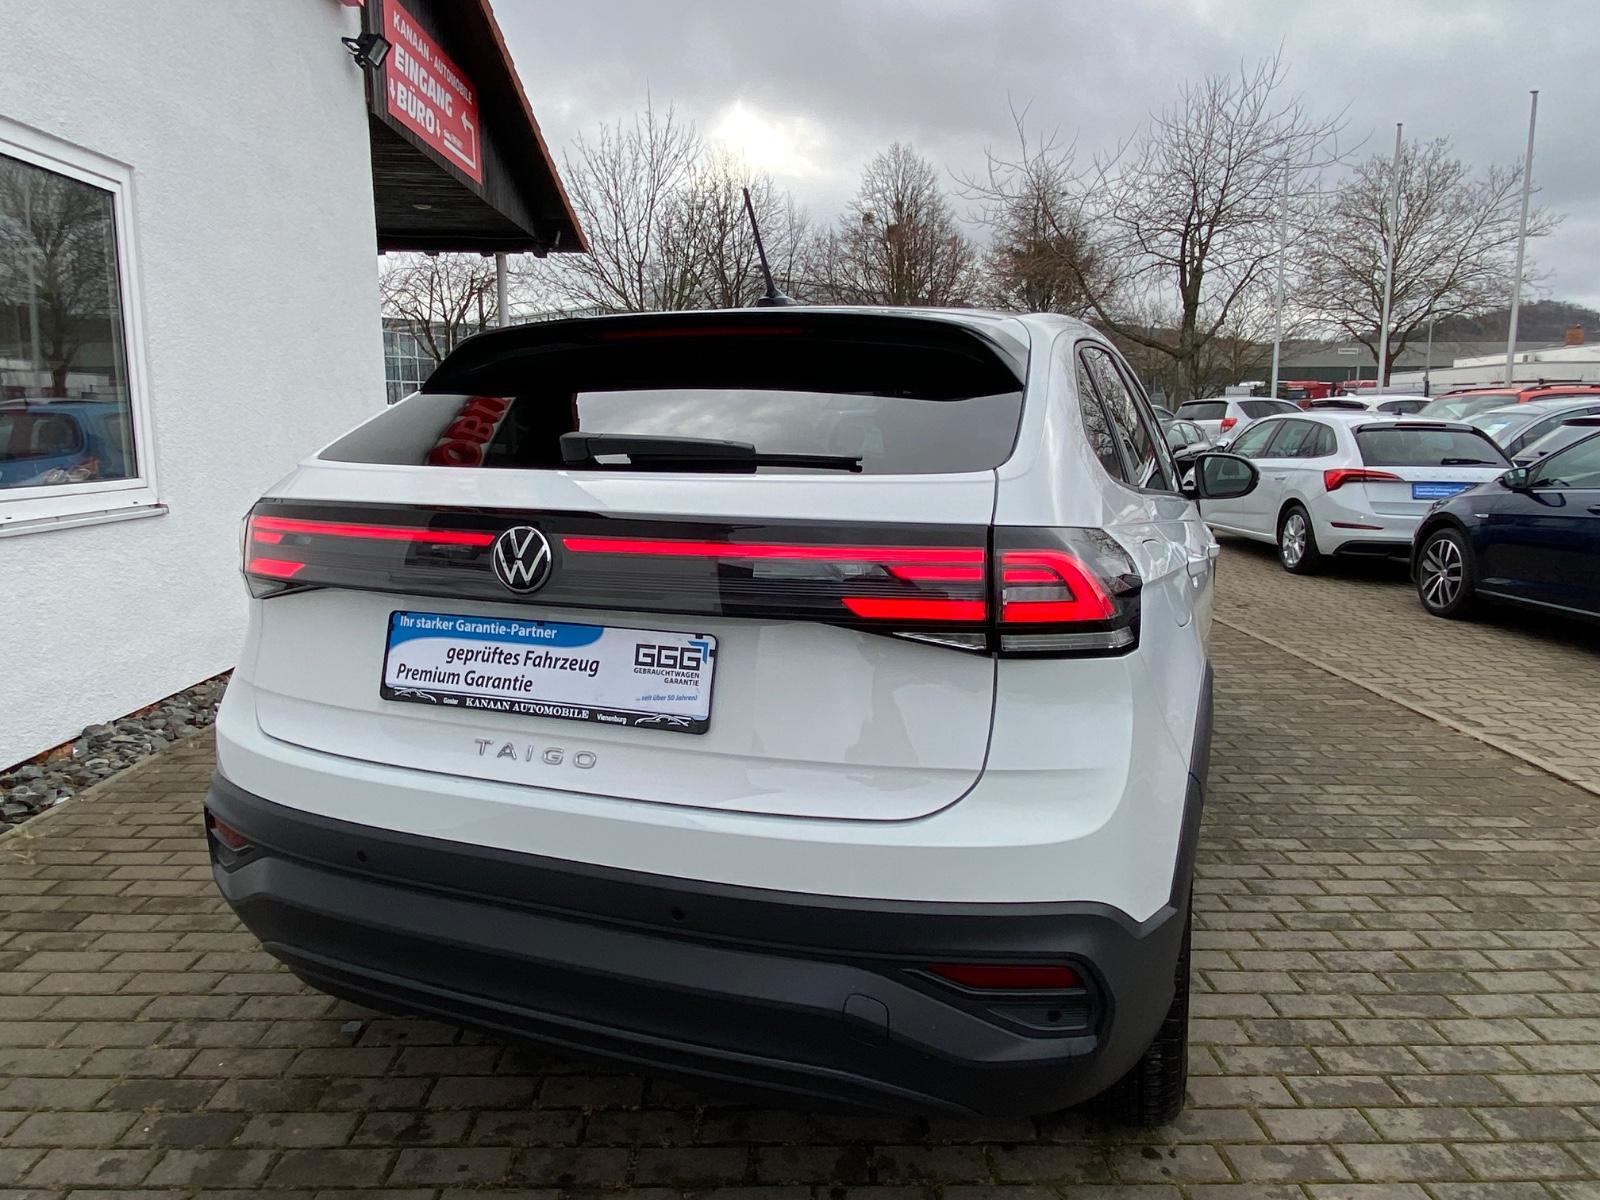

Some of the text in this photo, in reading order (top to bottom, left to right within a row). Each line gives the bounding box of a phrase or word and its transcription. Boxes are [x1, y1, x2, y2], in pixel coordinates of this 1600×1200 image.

[393, 11, 430, 62] KANAAN
[433, 56, 473, 105] AUTOMOBILE
[394, 42, 453, 118] EINGANG
[396, 82, 435, 135] BÜRO
[400, 615, 557, 639] Ihr starker Garantie-Partner
[446, 646, 600, 677] geprüftes Fahrzeug
[634, 643, 702, 671] GGG
[396, 663, 533, 692] Premium Garantie
[633, 667, 700, 679] GEBRAUCHTWAGEN
[664, 677, 700, 687] GARANTIE
[466, 697, 511, 711] KANAAN
[512, 702, 590, 720] AUTOMOBILE
[475, 738, 597, 770] TAIGO
